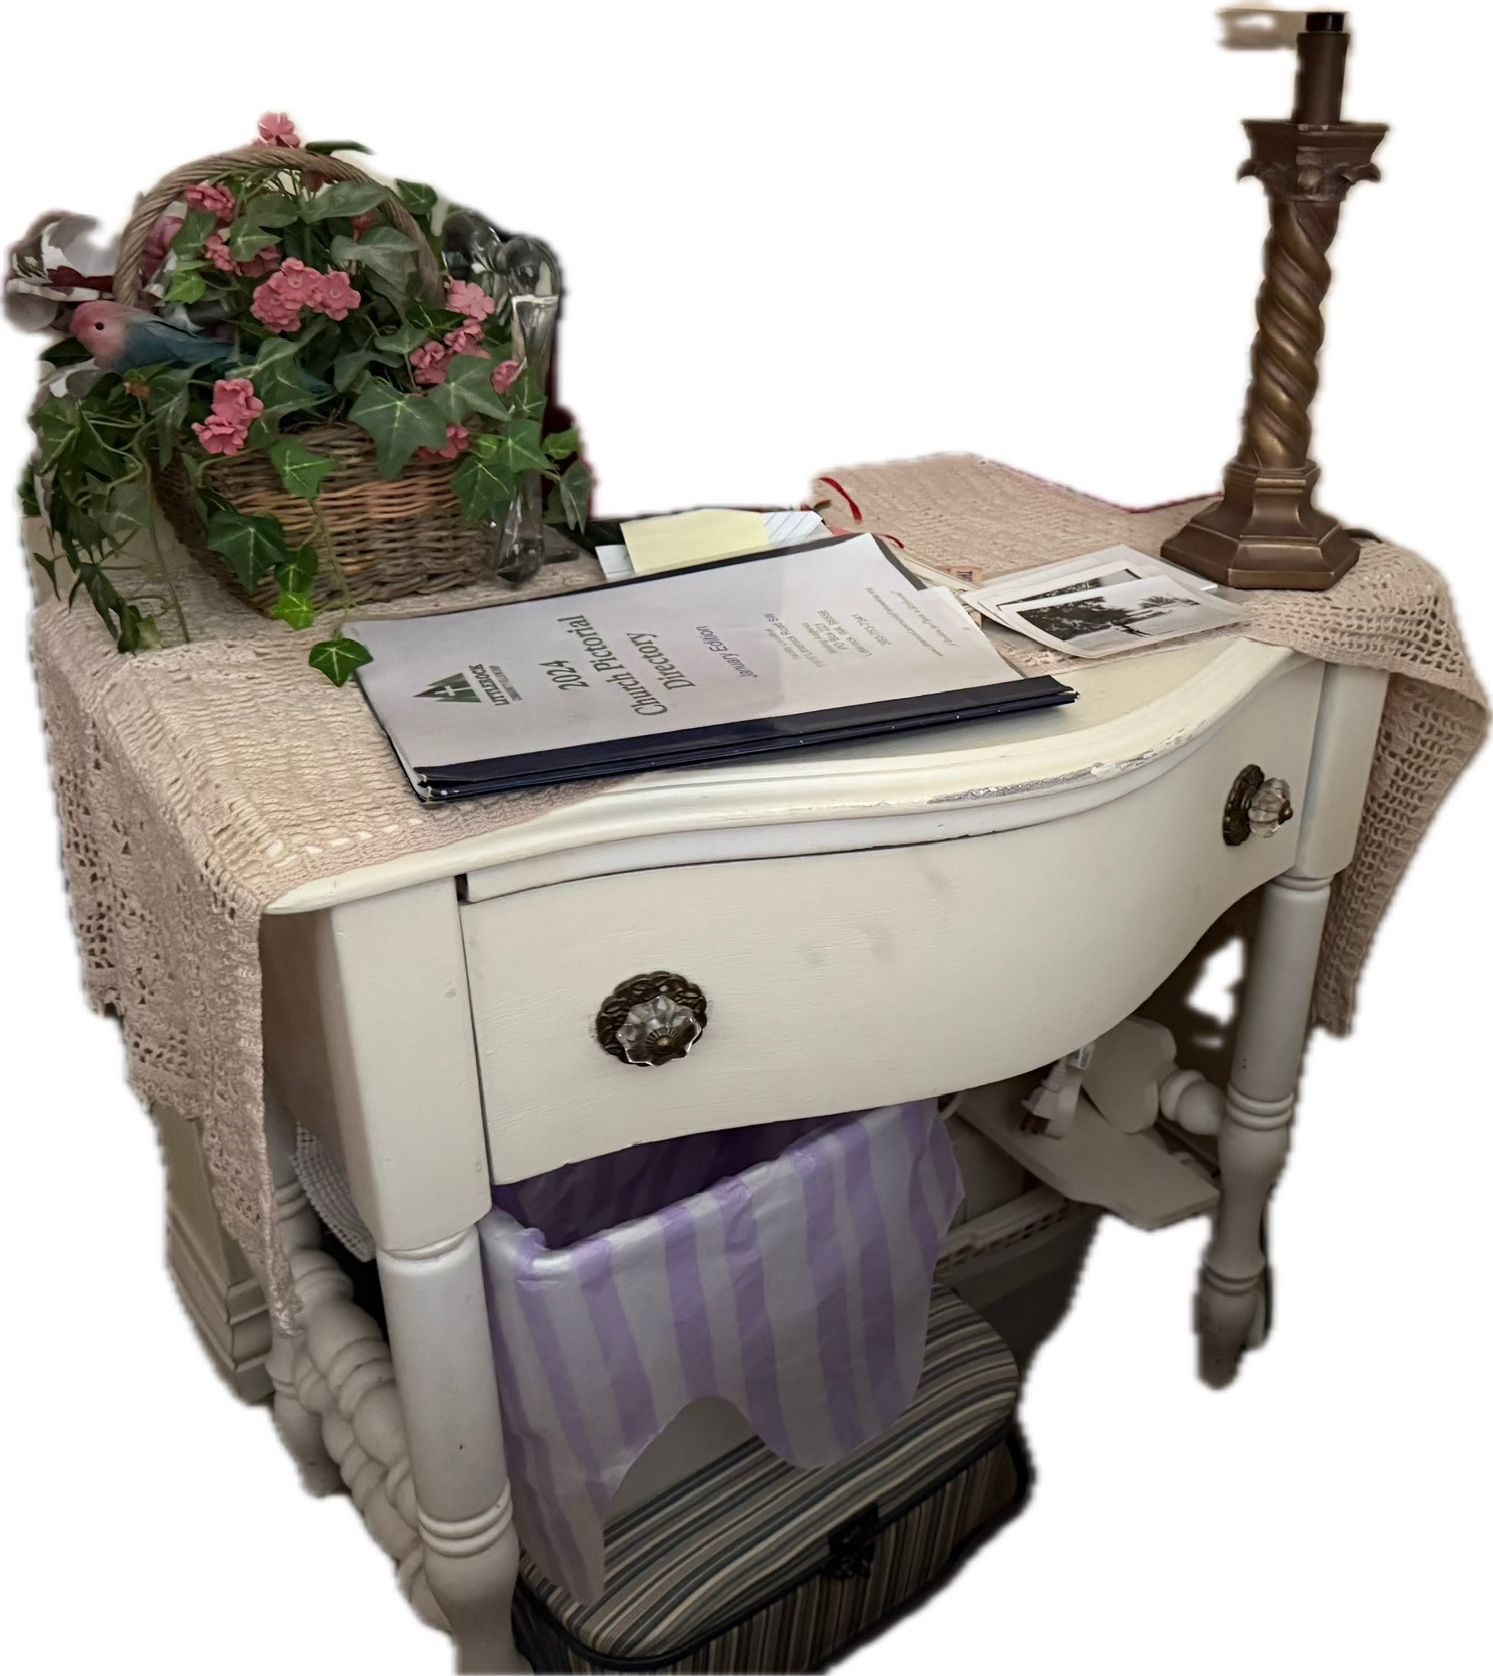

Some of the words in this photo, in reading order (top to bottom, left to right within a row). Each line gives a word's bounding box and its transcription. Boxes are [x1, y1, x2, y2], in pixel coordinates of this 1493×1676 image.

[557, 614, 625, 672] Pictorial
[696, 626, 728, 651] Edition
[539, 660, 589, 690] 2024
[626, 633, 696, 690] Directory
[720, 654, 759, 678] January
[605, 672, 667, 715] Church
